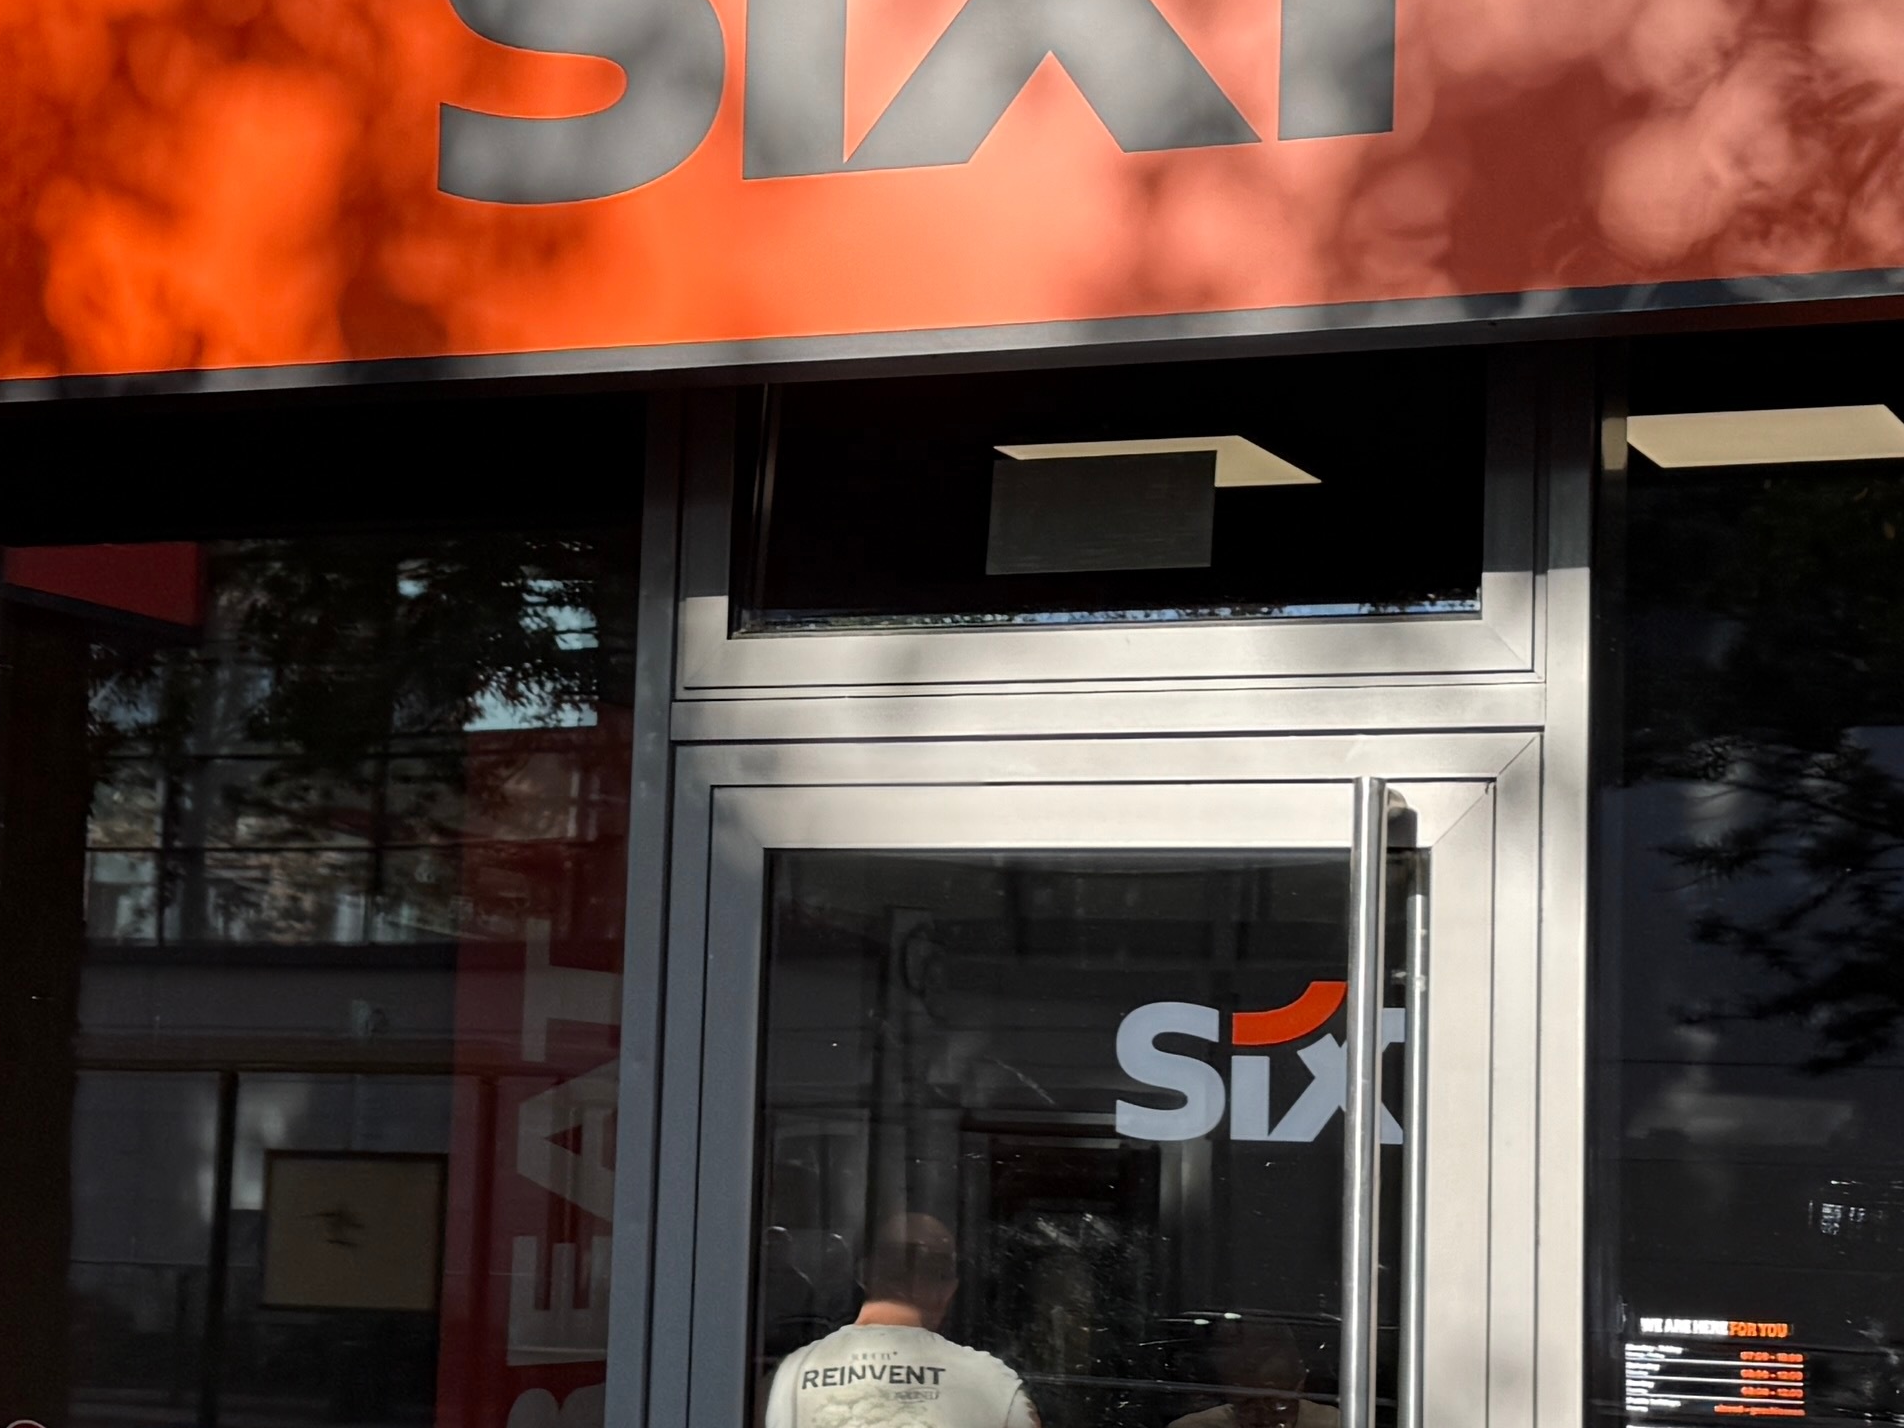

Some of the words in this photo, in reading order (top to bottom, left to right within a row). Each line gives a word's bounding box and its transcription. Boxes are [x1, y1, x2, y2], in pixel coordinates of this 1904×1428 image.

[1729, 1321, 1757, 1337] FOR
[1757, 1323, 1788, 1338] YOU
[801, 1365, 946, 1390] REINVENT
